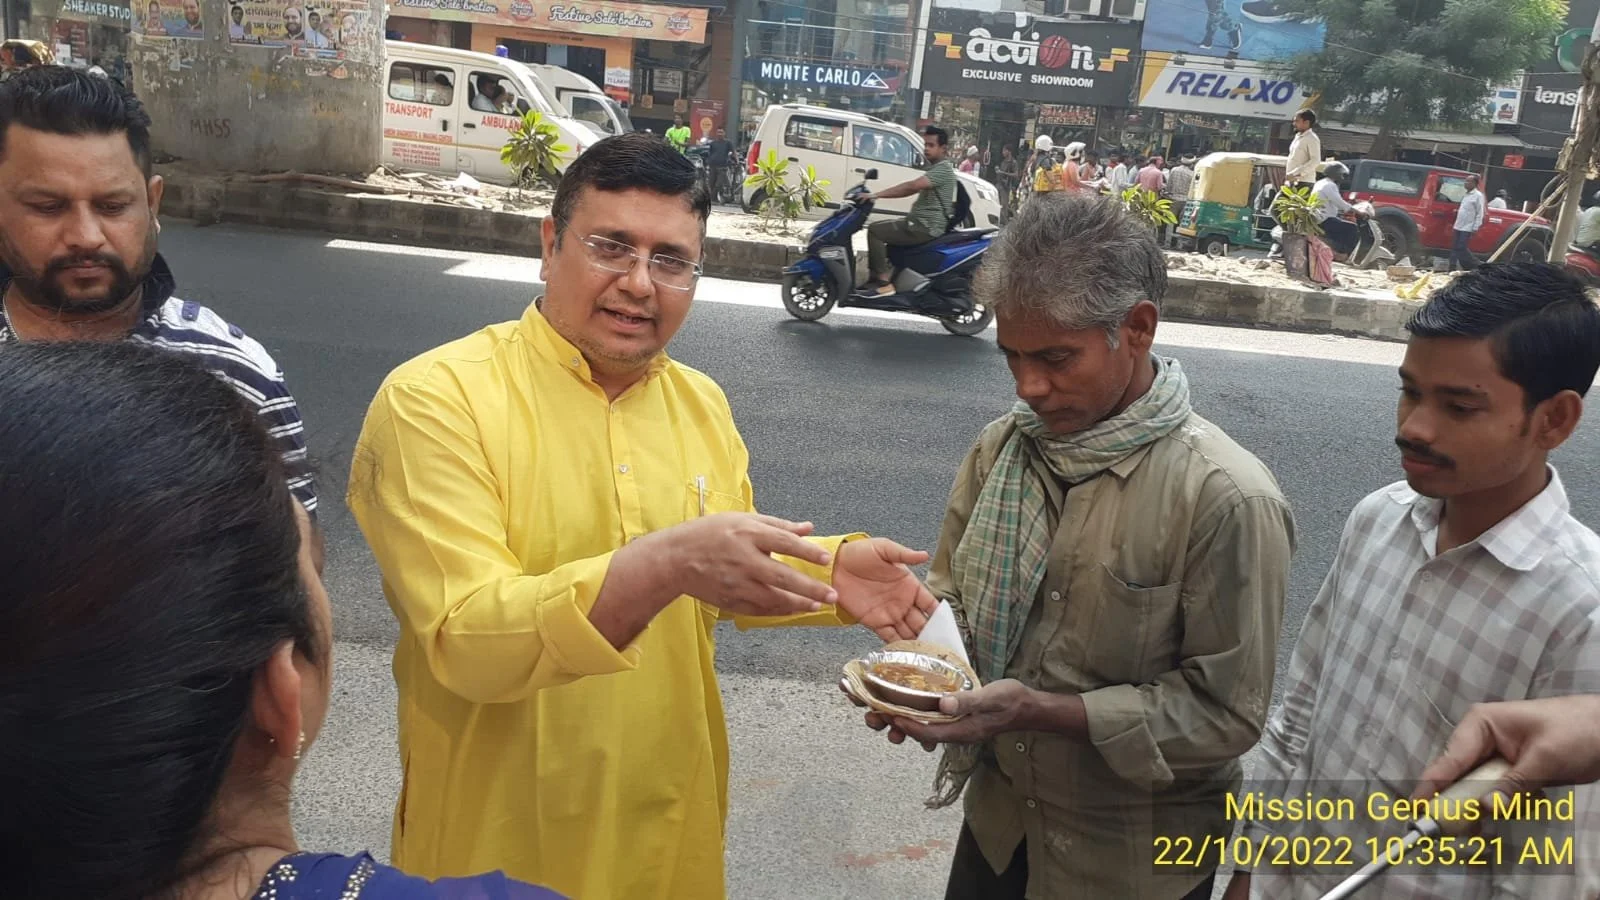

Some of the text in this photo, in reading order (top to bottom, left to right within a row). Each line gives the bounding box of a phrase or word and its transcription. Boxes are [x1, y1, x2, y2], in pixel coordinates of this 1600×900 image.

[65, 0, 108, 16] SNEAKER
[549, 5, 593, 24] Festive
[965, 27, 1095, 71] action
[761, 62, 810, 82] MONTE
[815, 67, 861, 86] CARLO
[962, 69, 1094, 88] EXCLUSIVE SHOWROOM
[1165, 71, 1295, 105] RELAXO
[385, 102, 433, 119] TRANSPORT
